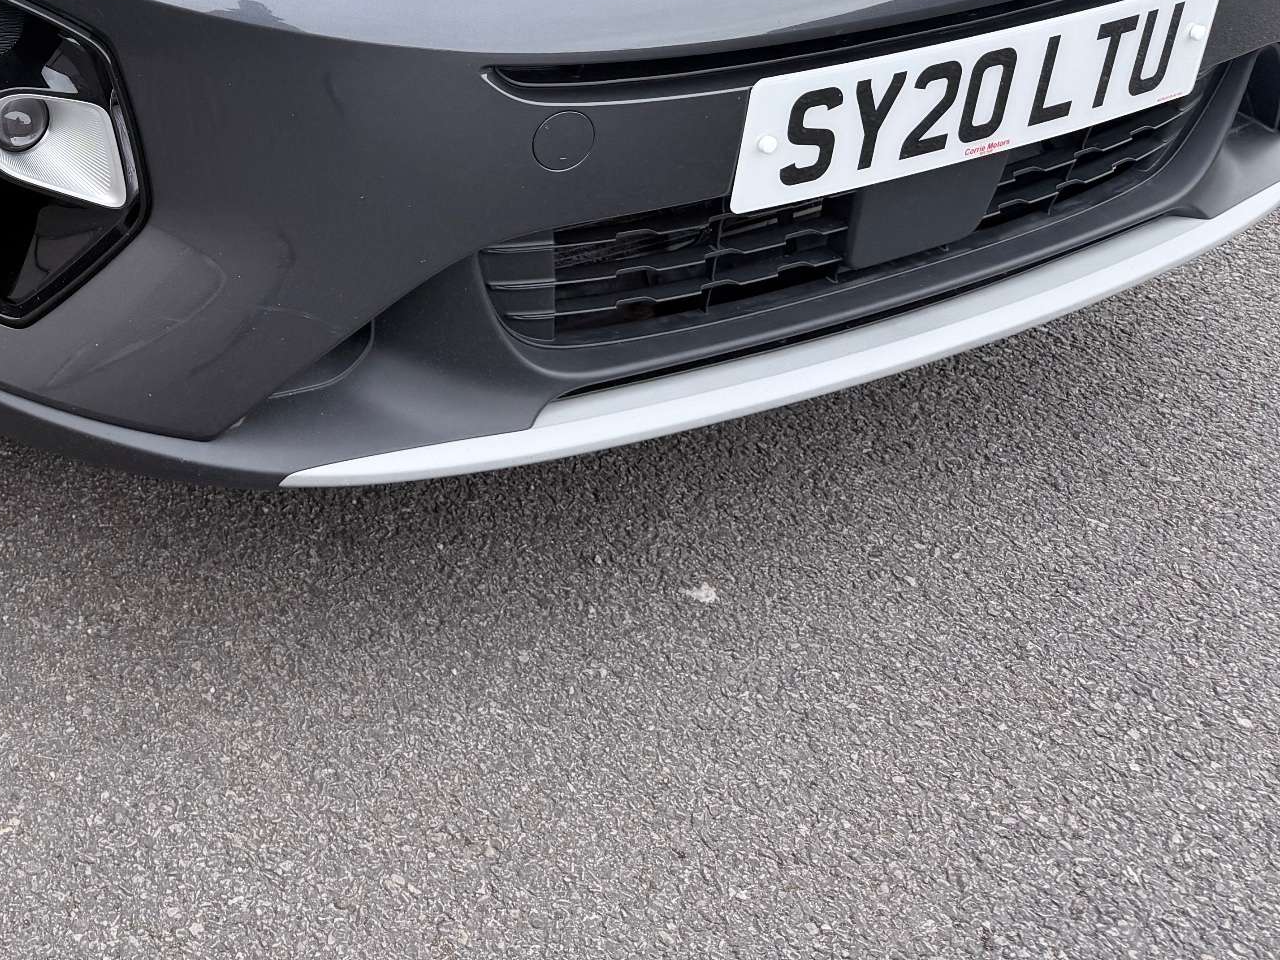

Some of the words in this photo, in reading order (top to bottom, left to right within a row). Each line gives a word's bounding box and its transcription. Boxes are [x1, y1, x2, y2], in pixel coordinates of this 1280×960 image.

[779, 47, 1018, 186] SY20
[1027, 1, 1186, 126] LTU
[986, 139, 1010, 151] Motors
